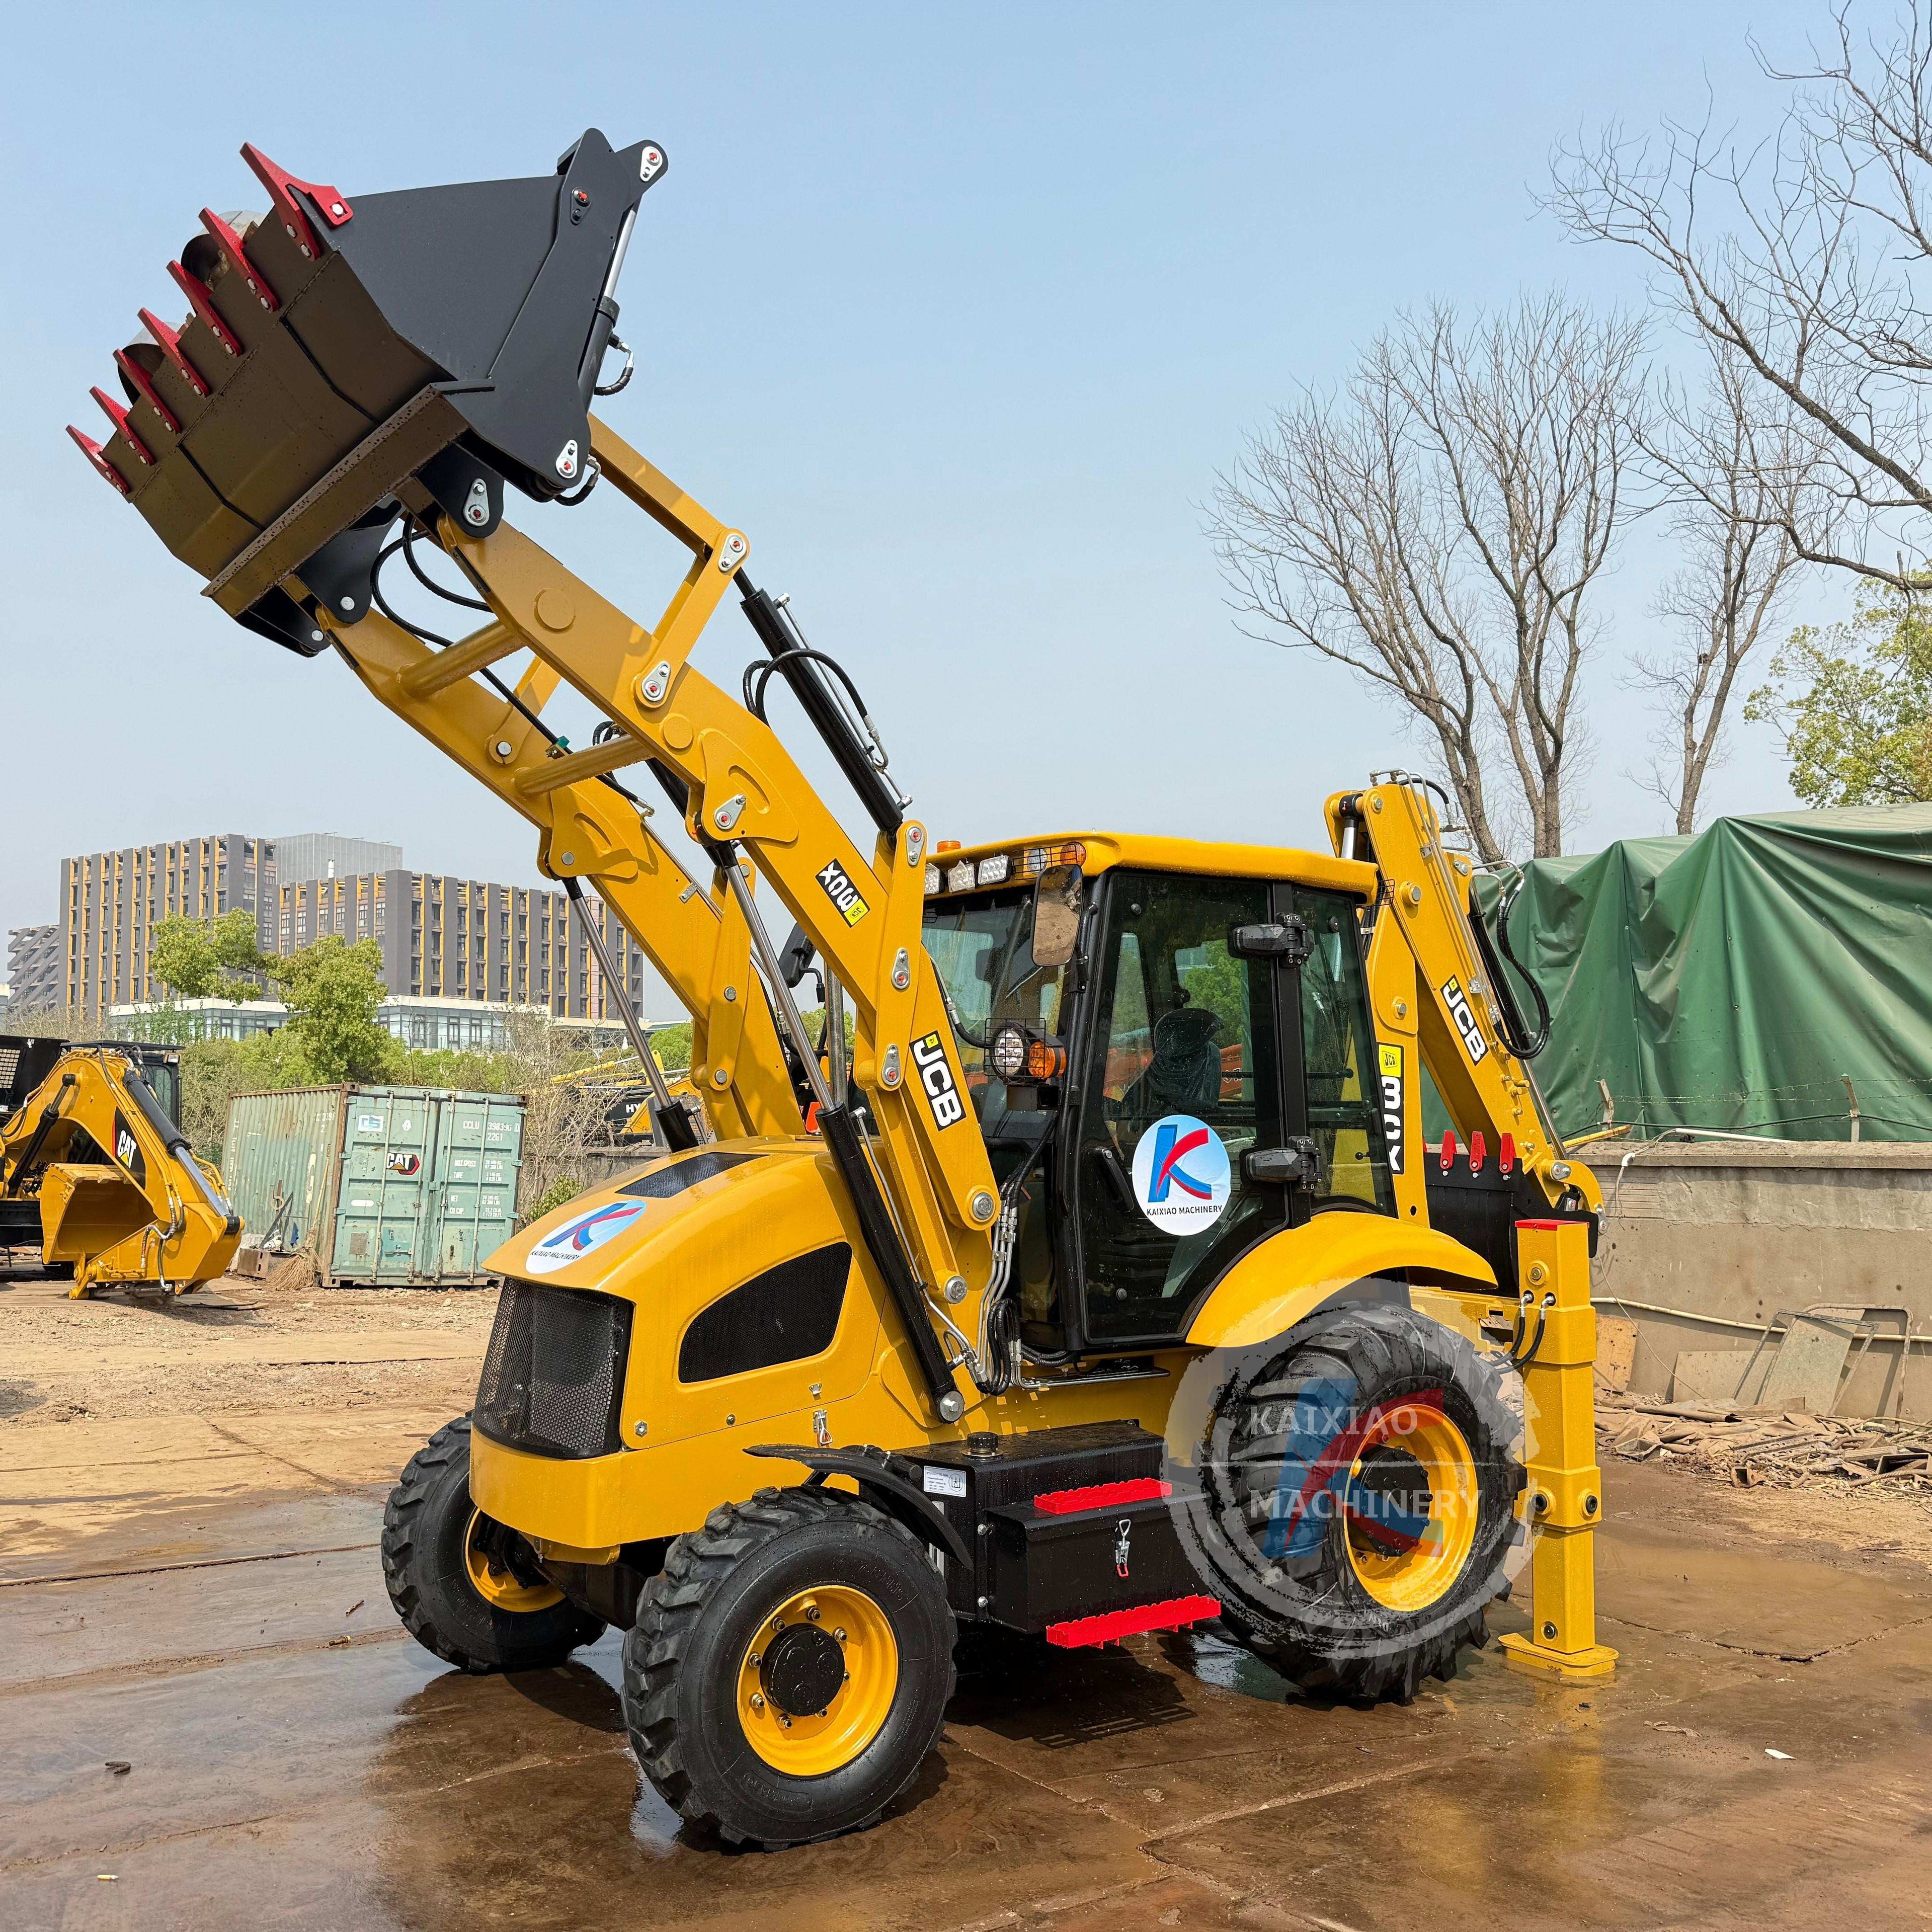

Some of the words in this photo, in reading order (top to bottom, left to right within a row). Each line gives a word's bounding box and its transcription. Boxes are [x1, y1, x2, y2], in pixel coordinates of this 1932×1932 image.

[1443, 985, 1486, 1062] JCB
[1385, 1053, 1396, 1066] JCB
[913, 1040, 962, 1126] JCB
[462, 1120, 480, 1130] CCLU
[487, 1133, 503, 1142] 22G1
[117, 1130, 137, 1169] CAT
[386, 1153, 413, 1170] CAT
[1147, 1208, 1177, 1216] KAIXIAO
[1179, 1205, 1223, 1215] MACHINERY
